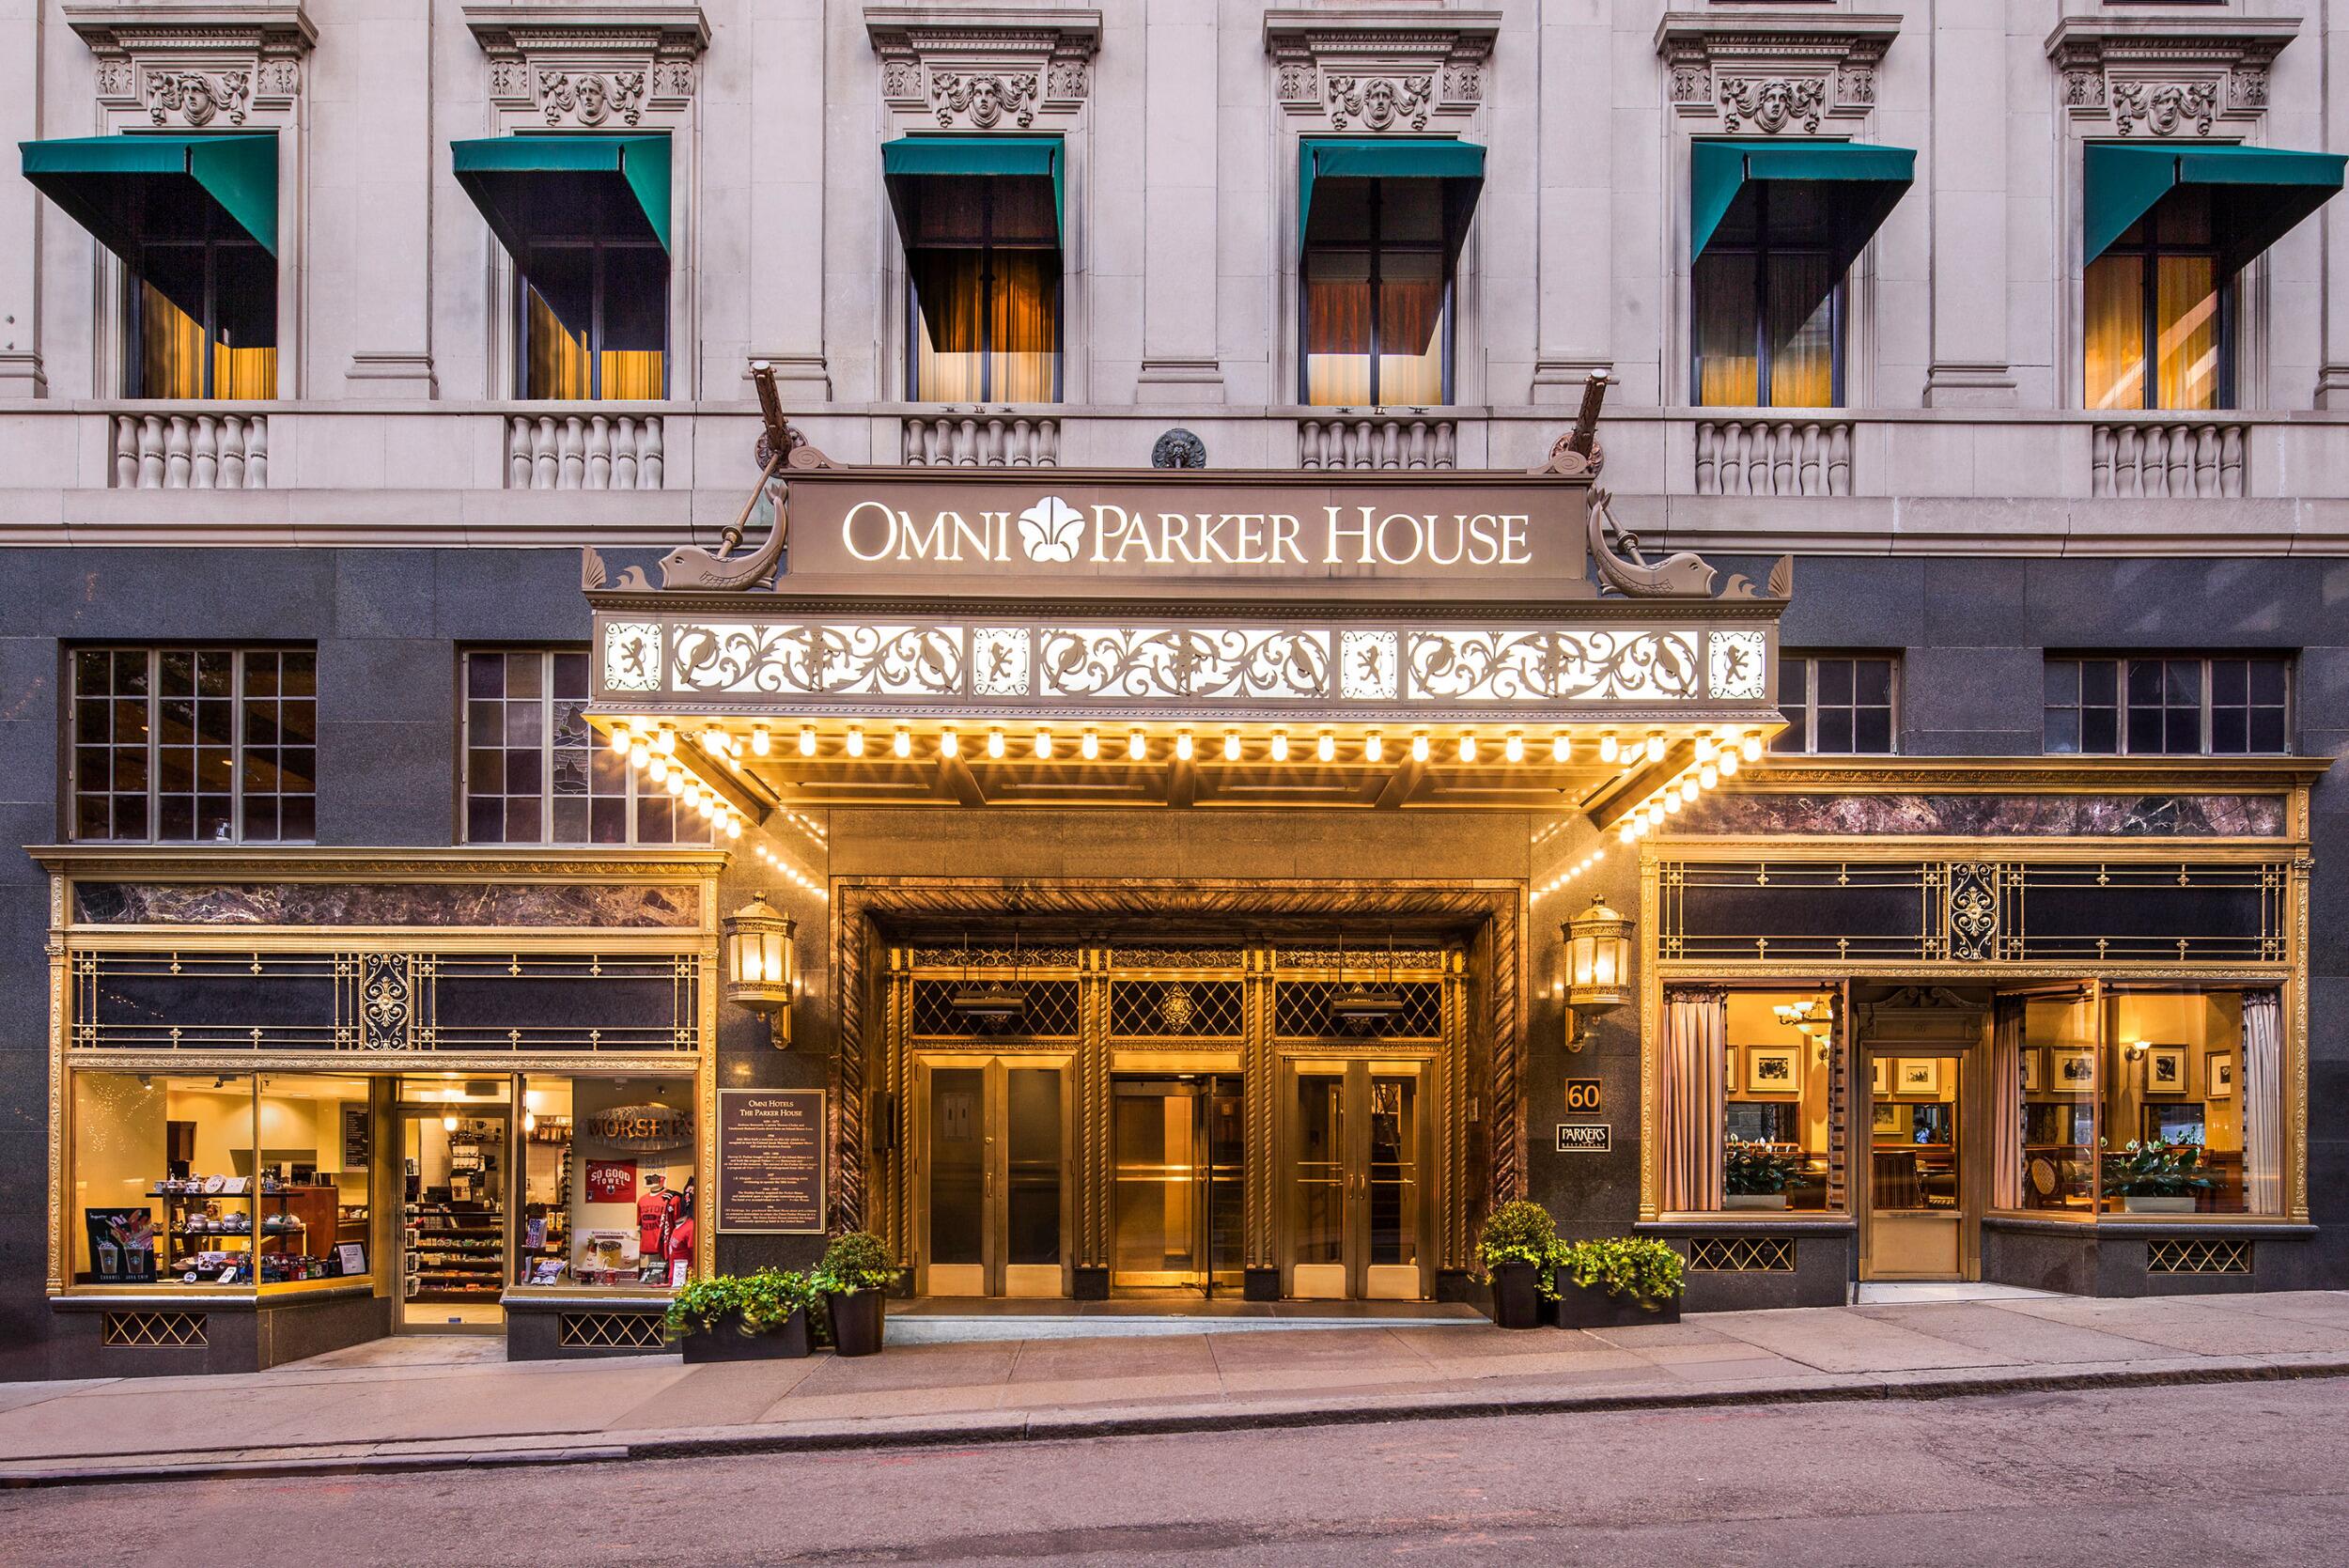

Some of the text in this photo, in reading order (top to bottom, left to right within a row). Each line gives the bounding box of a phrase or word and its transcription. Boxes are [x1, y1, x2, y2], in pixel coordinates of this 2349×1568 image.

[842, 501, 1532, 566] OMNI PARKER HOUSE
[748, 1099, 794, 1108] OMNI HOTELS
[1568, 1085, 1600, 1108] 60
[754, 1109, 779, 1117] PARKER
[780, 1109, 803, 1117] HOUSE
[1562, 1127, 1606, 1143] PARKER'S
[591, 1169, 631, 1182] SO GOOD
